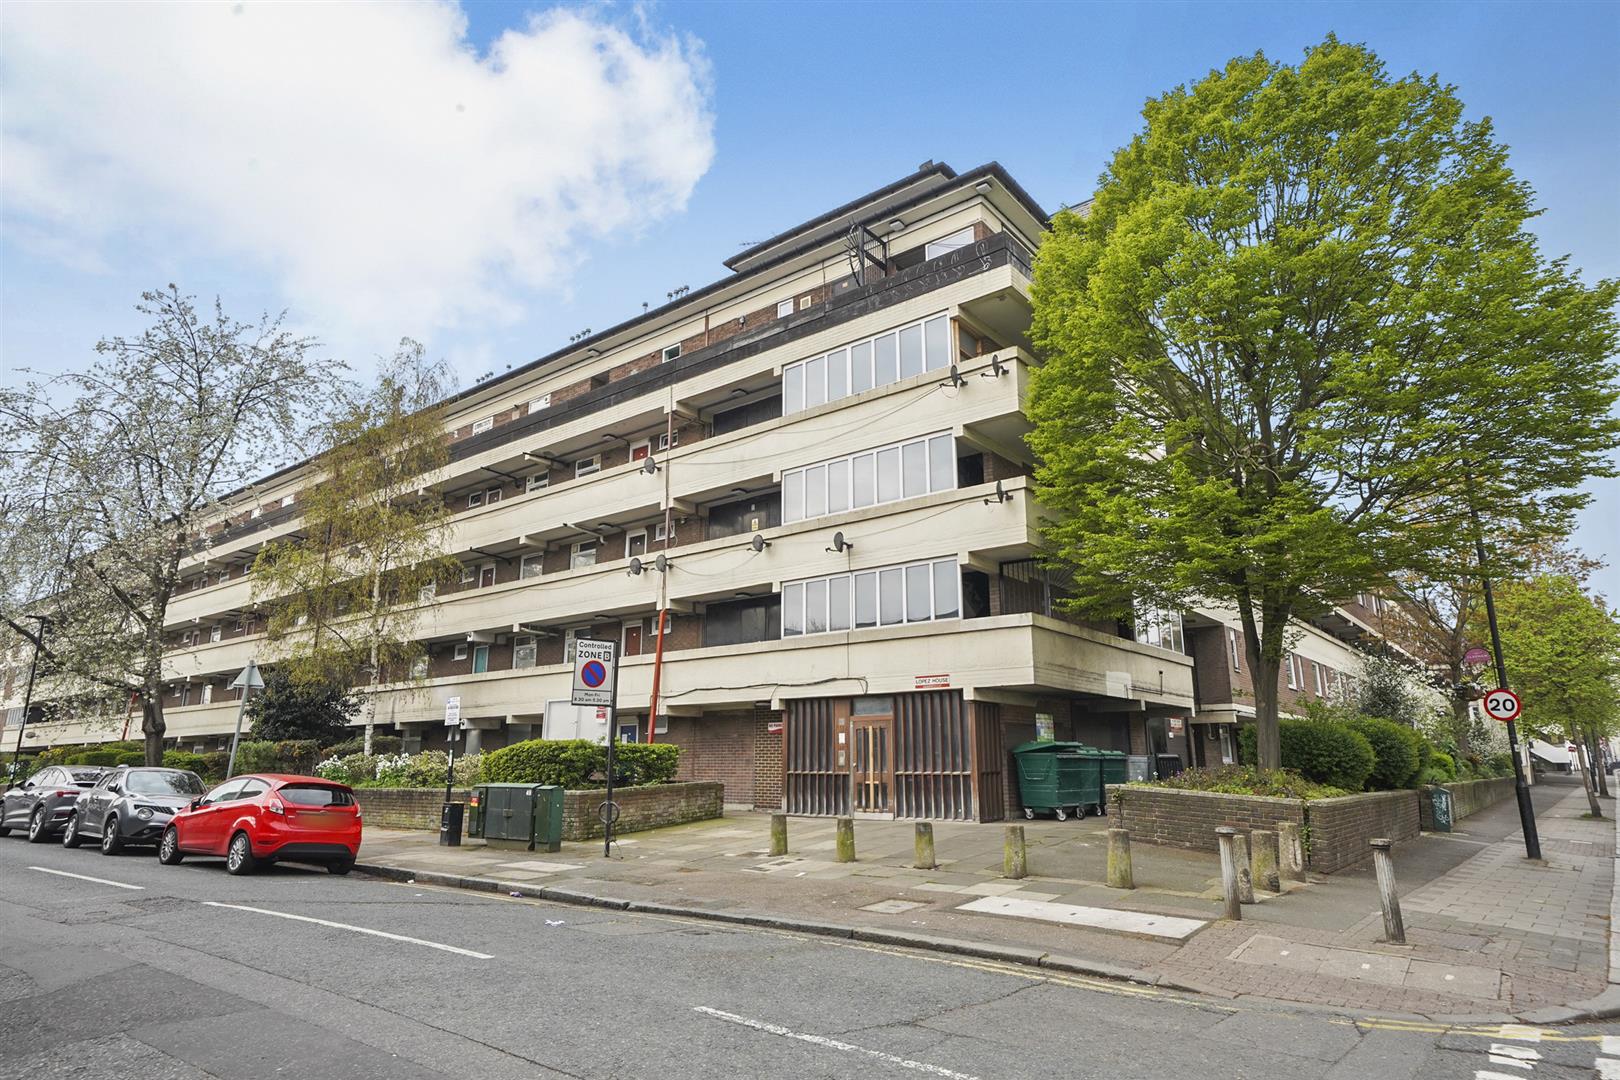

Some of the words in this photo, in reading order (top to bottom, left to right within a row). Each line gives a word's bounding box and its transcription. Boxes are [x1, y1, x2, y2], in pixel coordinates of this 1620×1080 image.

[579, 642, 612, 650] Controlled
[578, 650, 602, 659] ZONE
[1489, 698, 1515, 711] 20
